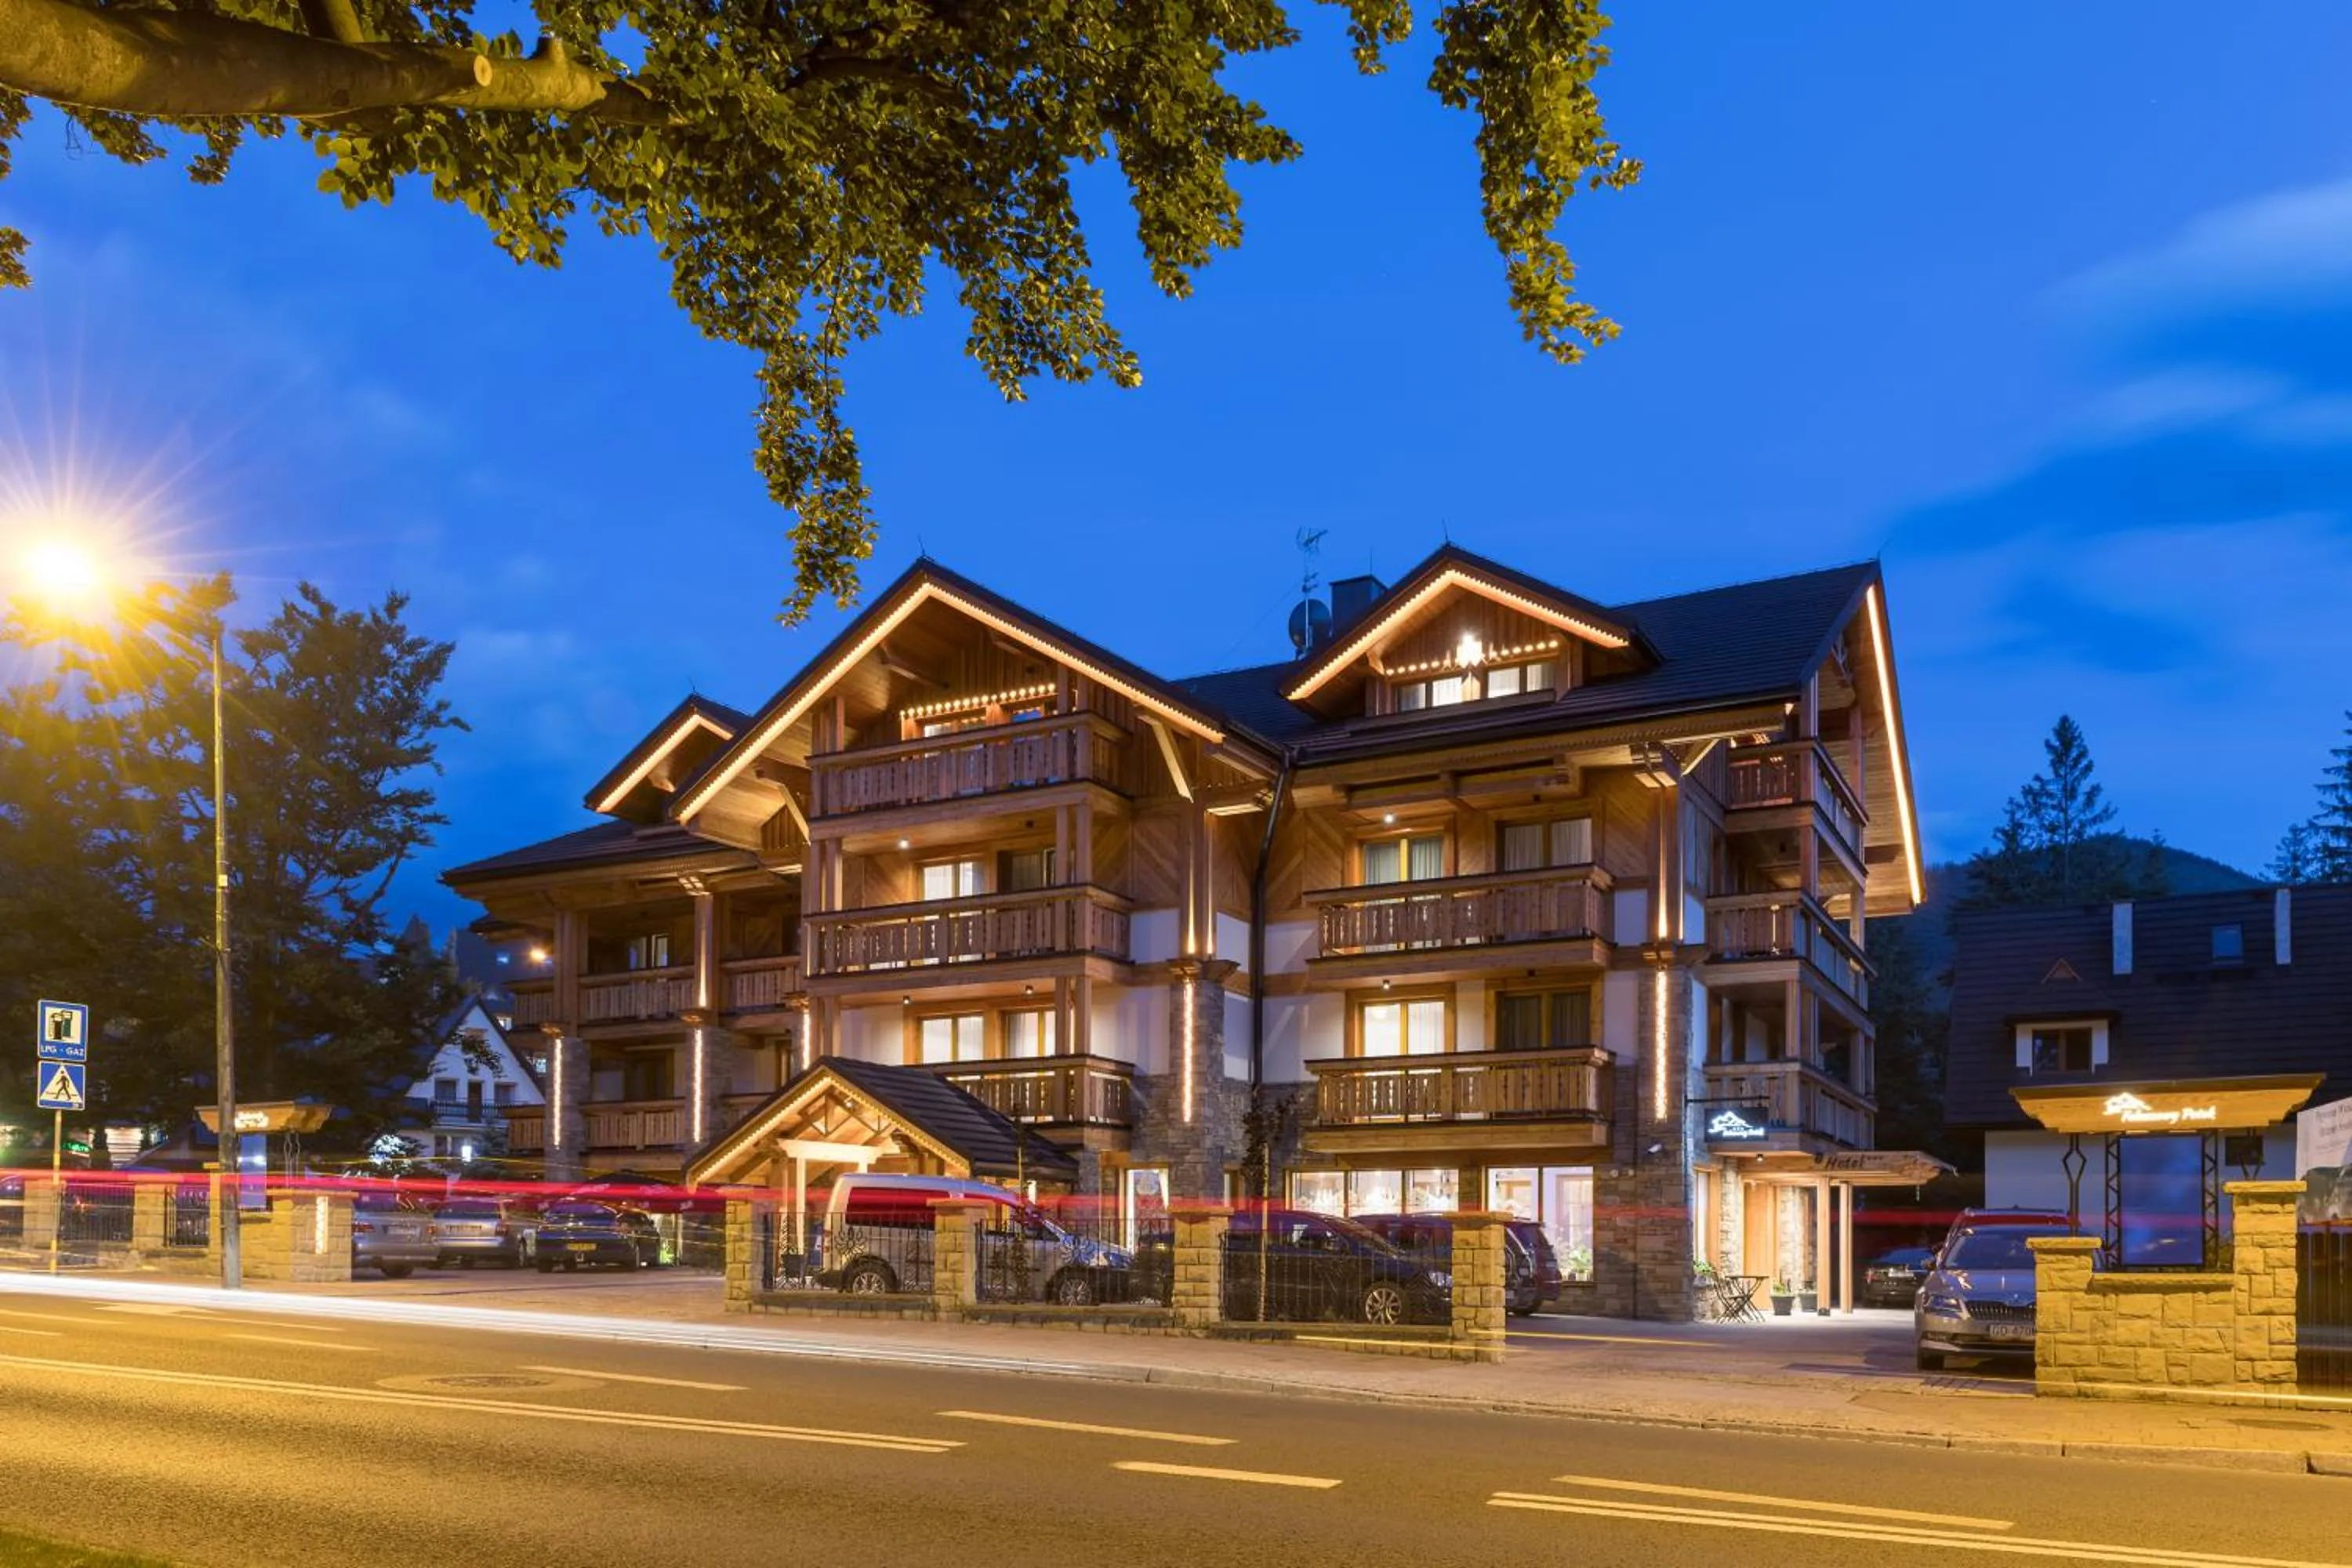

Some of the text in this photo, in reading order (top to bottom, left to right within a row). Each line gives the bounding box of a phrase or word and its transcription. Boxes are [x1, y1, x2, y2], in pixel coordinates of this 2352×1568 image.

[41, 1044, 57, 1054] LPG
[66, 1047, 84, 1056] GAZ
[1825, 1154, 1864, 1169] Hotel
[2012, 1326, 2035, 1337] 470
